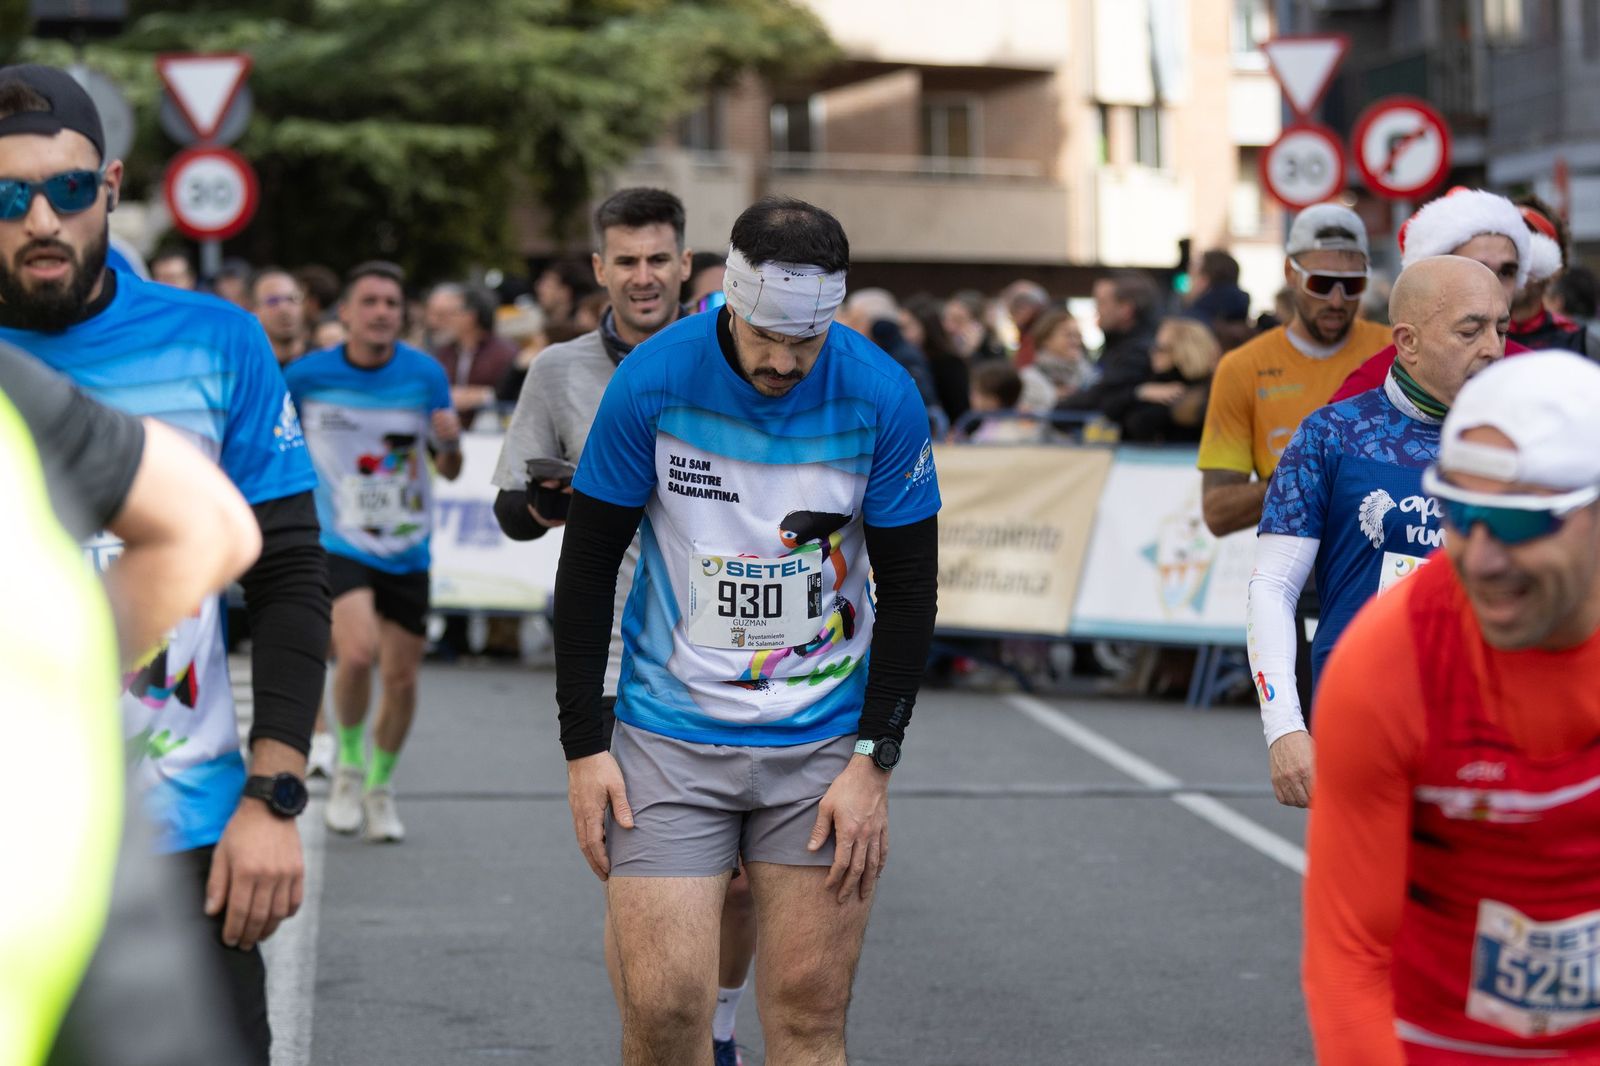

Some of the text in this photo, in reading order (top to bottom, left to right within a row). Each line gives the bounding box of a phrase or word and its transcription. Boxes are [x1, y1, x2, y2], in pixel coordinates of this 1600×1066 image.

[1283, 152, 1328, 185] 30
[188, 176, 233, 211] 30
[669, 454, 711, 472] XLI SAN
[669, 468, 722, 487] SILVESTRE
[668, 481, 740, 504] SALMANTINA
[726, 559, 810, 579] SETEL
[718, 580, 783, 619] 930
[732, 619, 767, 627] GUZMAN
[747, 633, 785, 641] Ayuntamiento
[756, 640, 785, 648] Salamanca
